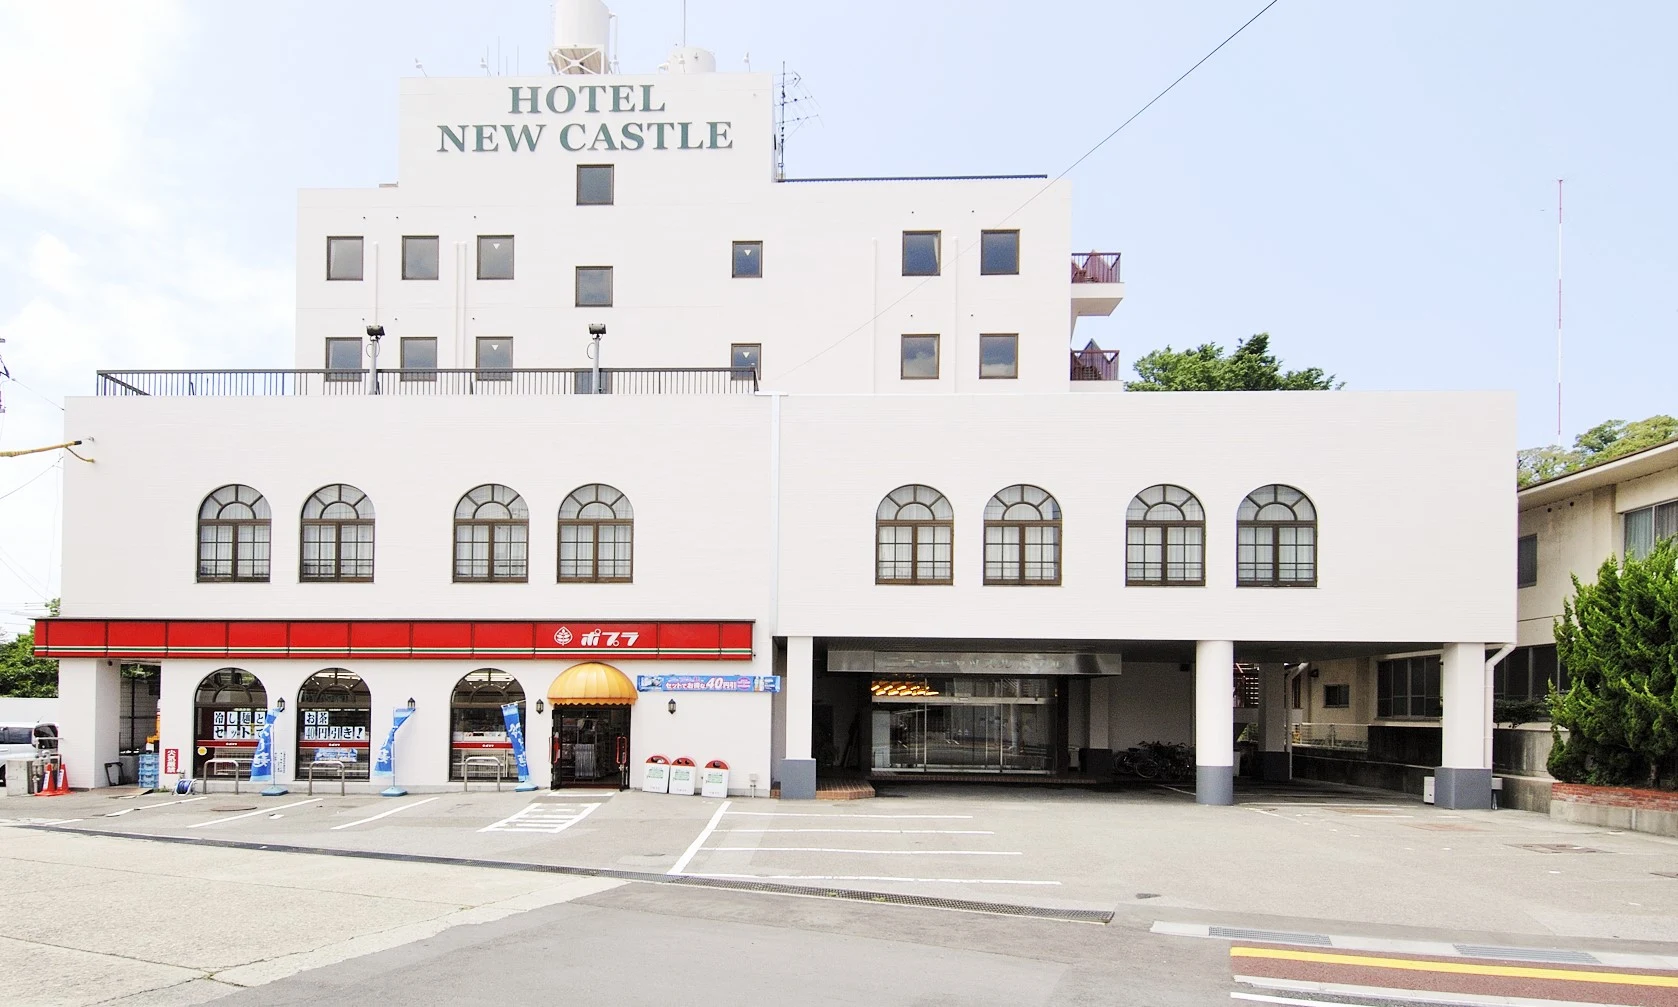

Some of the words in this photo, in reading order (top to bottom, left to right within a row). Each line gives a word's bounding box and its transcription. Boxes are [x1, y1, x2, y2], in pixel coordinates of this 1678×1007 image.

[507, 84, 666, 114] HOTEL
[436, 124, 547, 153] NEW
[559, 121, 734, 151] CASTLE
[581, 628, 639, 647] ポプラ
[214, 712, 265, 725] 冷し麺と
[306, 712, 328, 725] お茶
